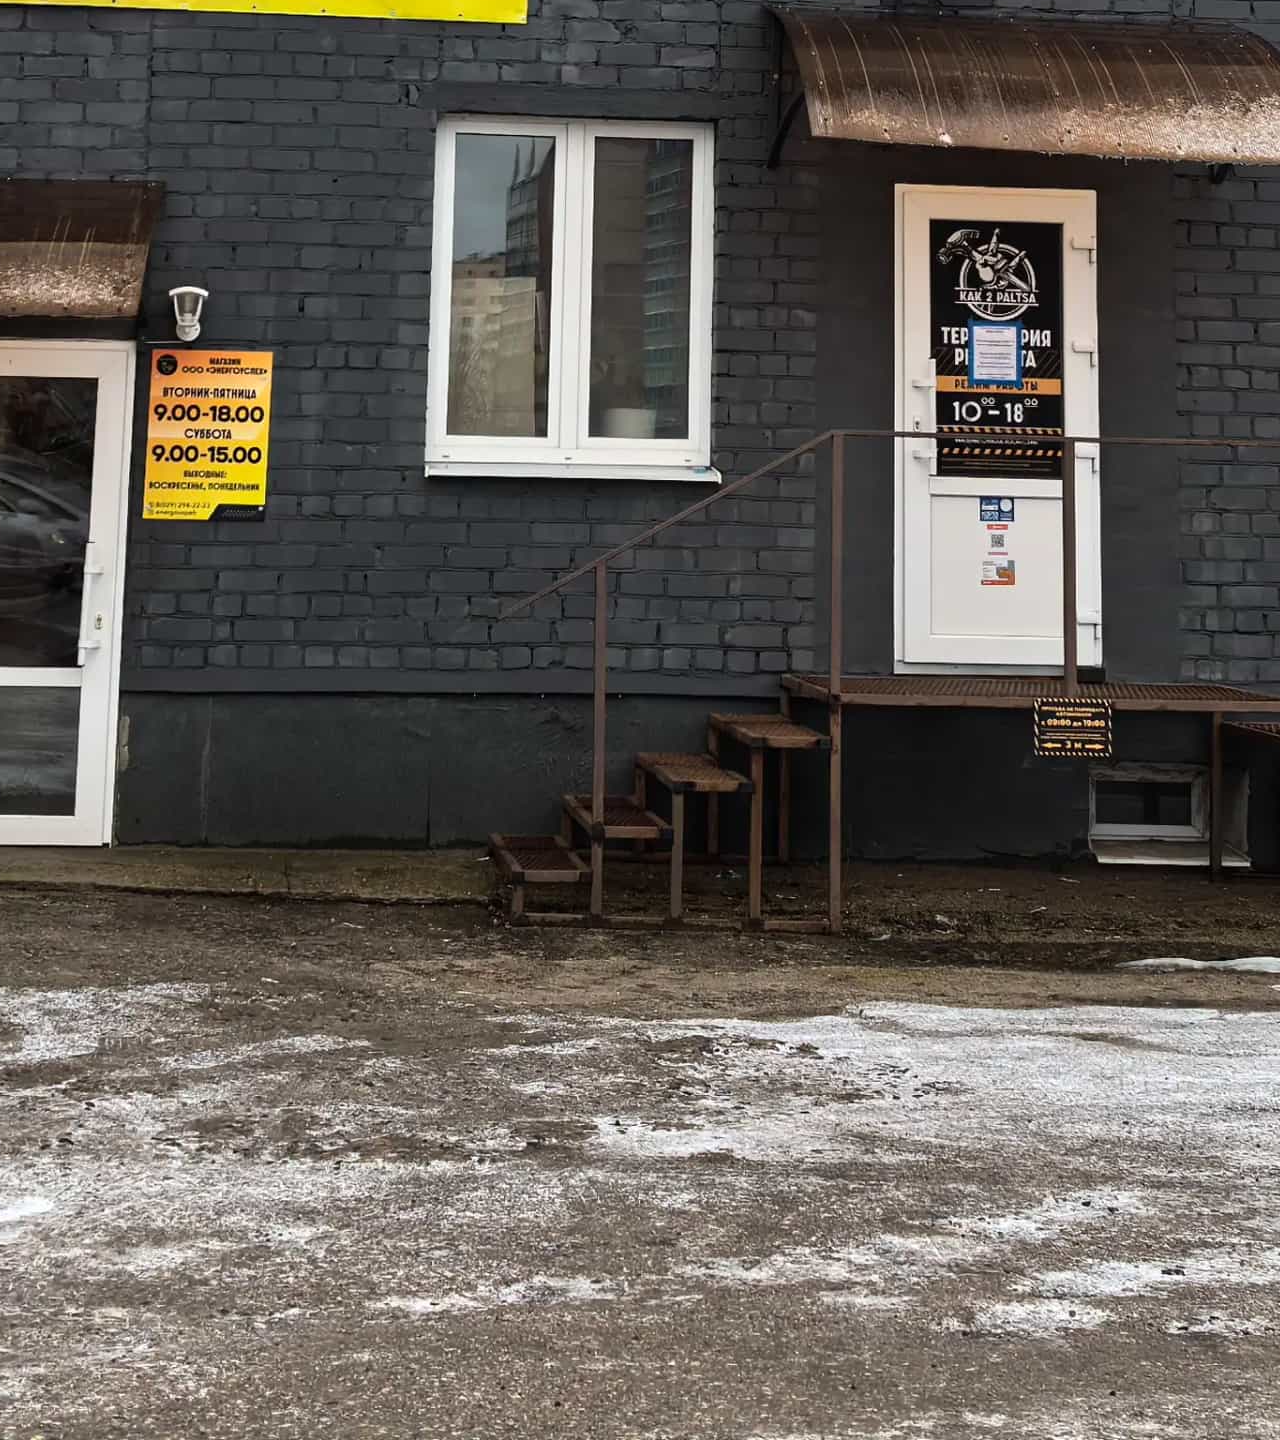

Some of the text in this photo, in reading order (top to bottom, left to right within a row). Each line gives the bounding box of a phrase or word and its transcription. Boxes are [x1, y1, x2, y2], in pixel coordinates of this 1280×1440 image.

[960, 291, 1036, 303] KAK 2 PALTSA
[182, 366, 204, 374] ООО
[184, 428, 232, 439] СУББОТА
